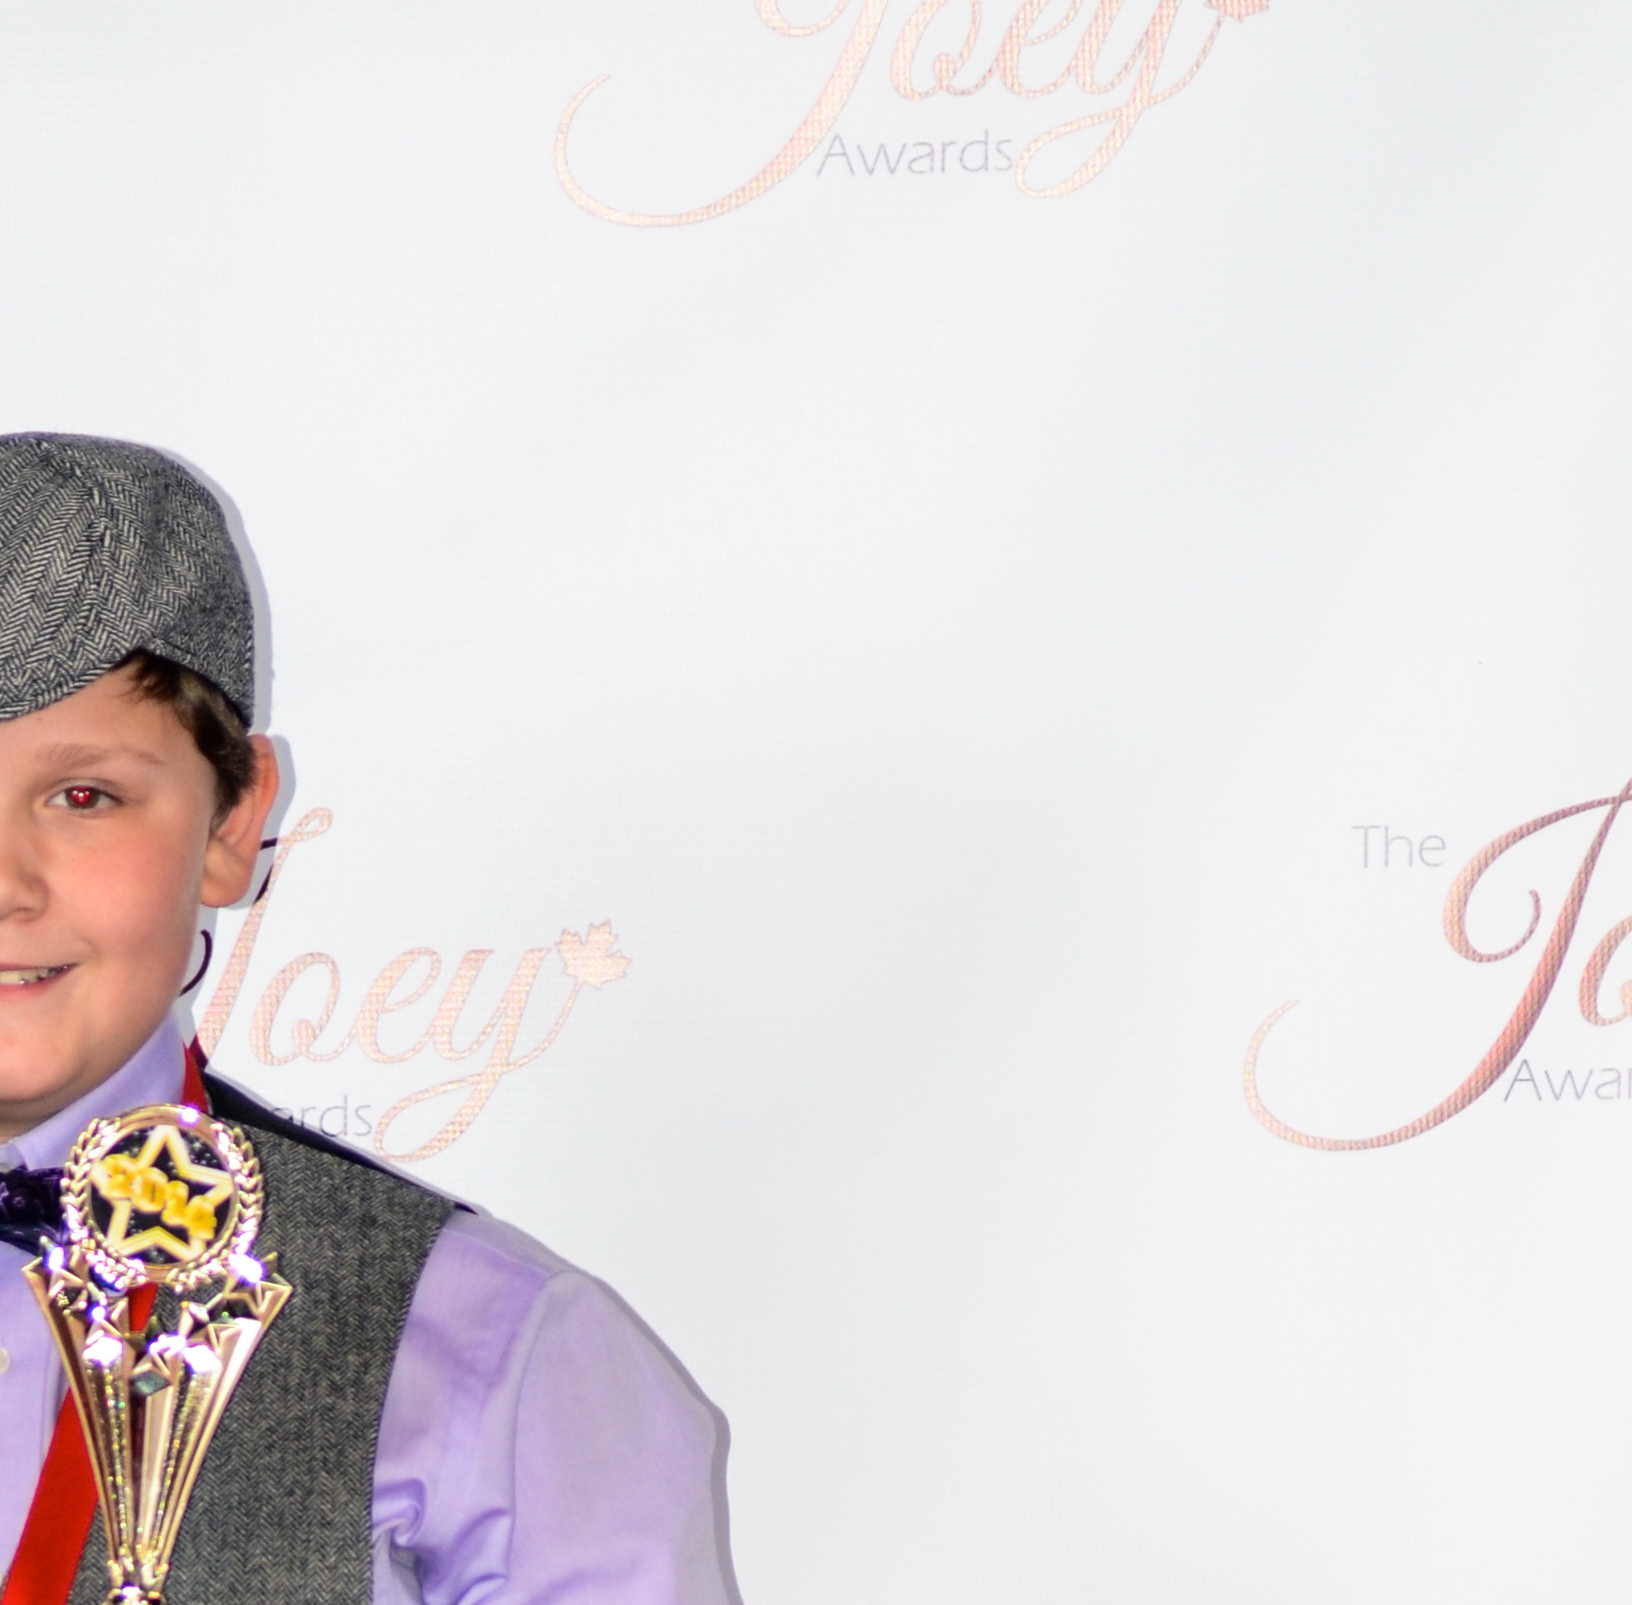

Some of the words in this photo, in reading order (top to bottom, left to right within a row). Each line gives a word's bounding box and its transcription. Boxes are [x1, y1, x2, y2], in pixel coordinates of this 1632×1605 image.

[815, 129, 1014, 178] Awards
[1352, 825, 1447, 868] The
[1243, 778, 1632, 1151] Jo
